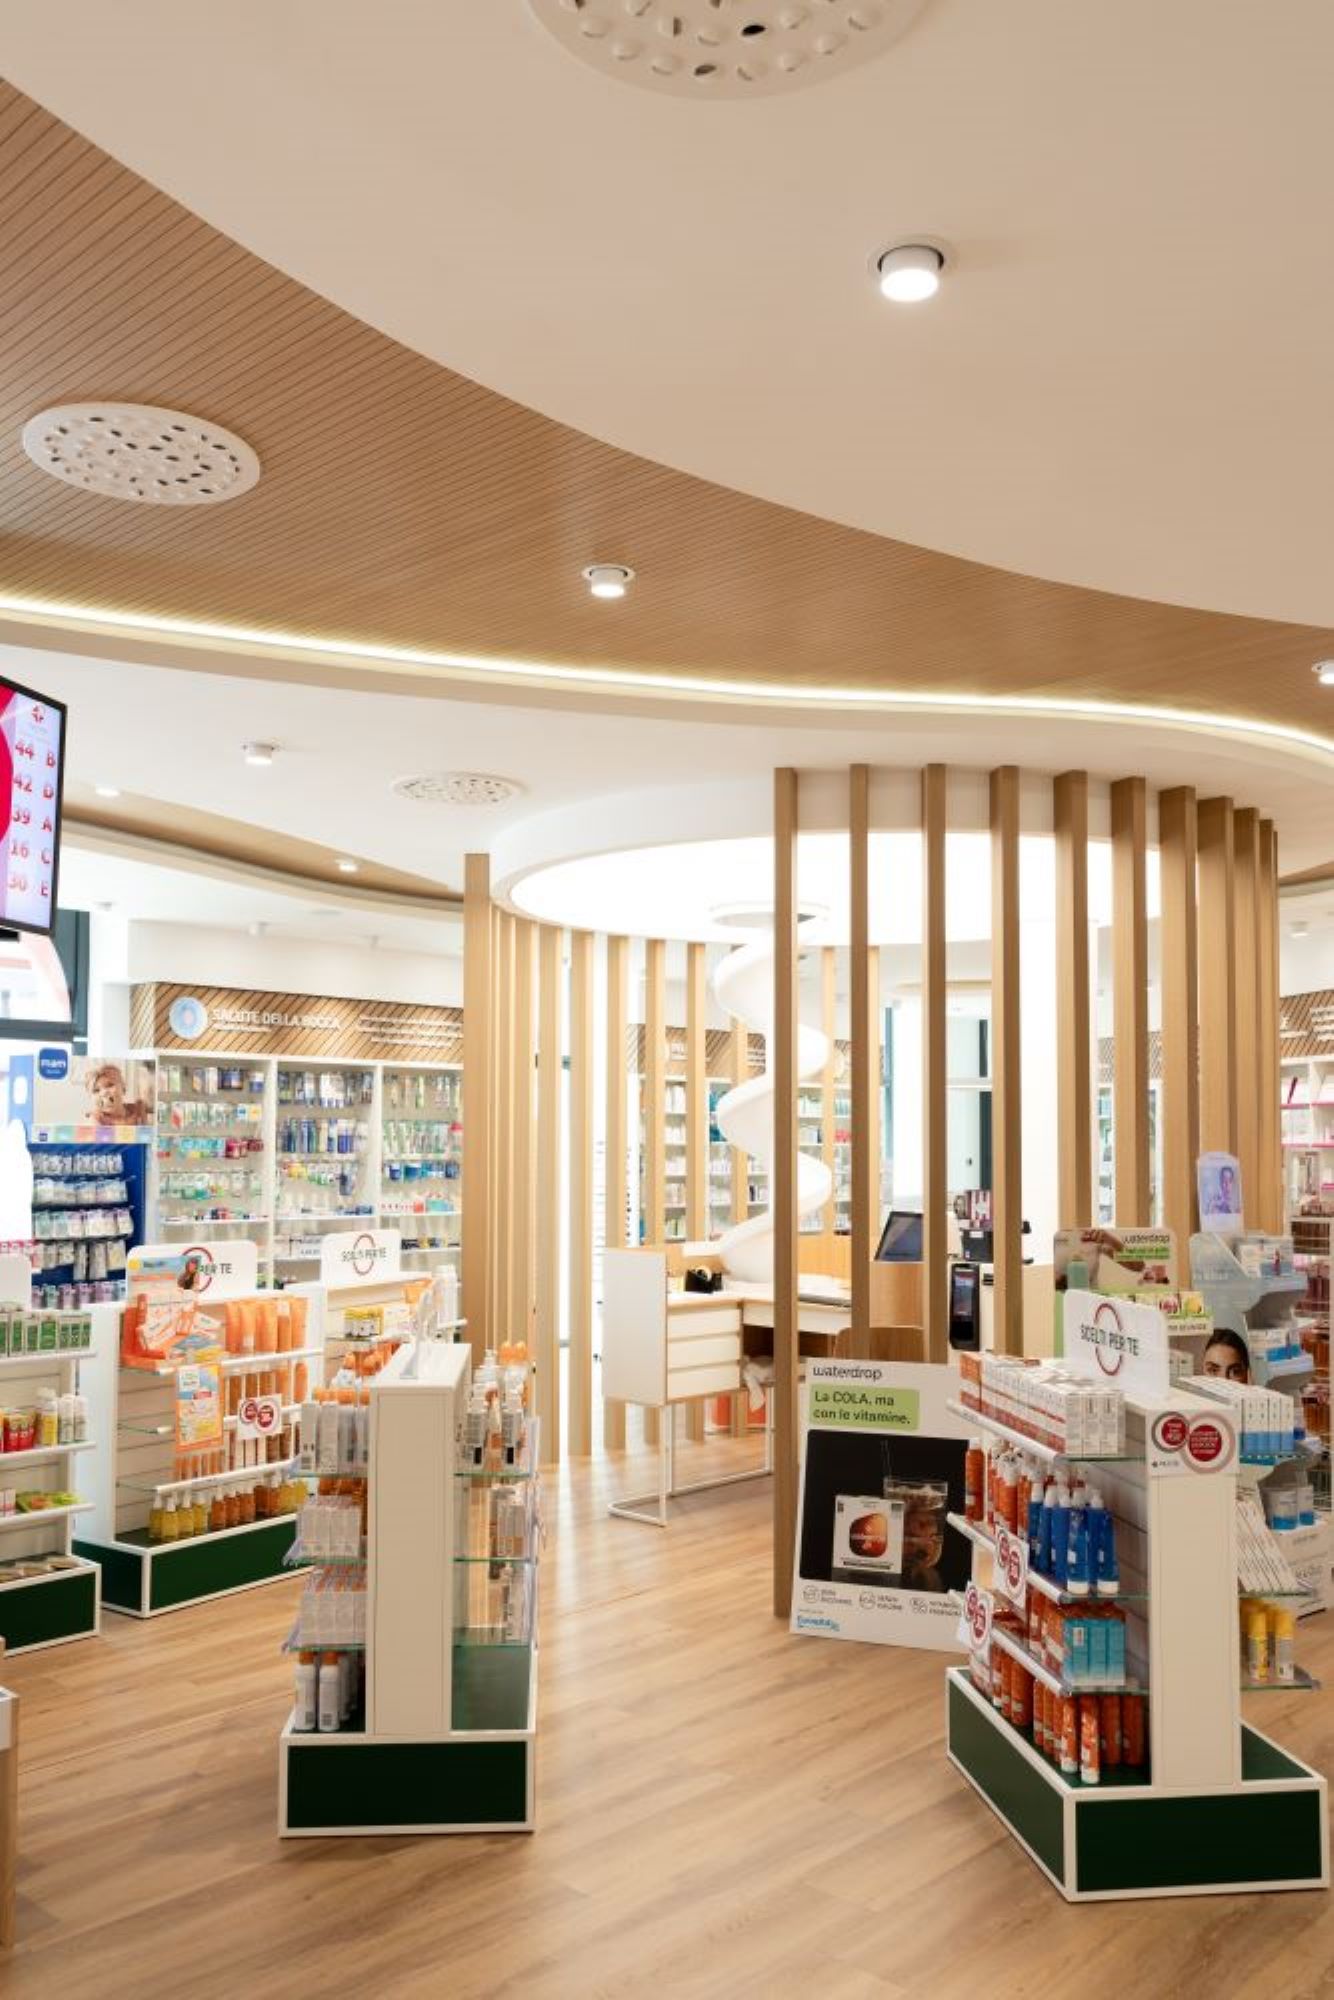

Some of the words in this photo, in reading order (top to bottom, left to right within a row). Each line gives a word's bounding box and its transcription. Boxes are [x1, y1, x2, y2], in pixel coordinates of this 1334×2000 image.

[15, 739, 35, 759] 44
[47, 751, 56, 767] B
[13, 775, 33, 793] 42
[12, 808, 30, 824] 39
[42, 817, 52, 832] A
[41, 849, 51, 865] C
[40, 882, 49, 898] E
[212, 1008, 260, 1024] SALUTE
[263, 1012, 300, 1026] DELLA
[220, 1263, 233, 1275] TE
[1080, 1323, 1107, 1346] SCELTI
[1109, 1332, 1126, 1352] PER
[1127, 1336, 1139, 1357] TE
[813, 1365, 883, 1383] waterdrop
[814, 1391, 830, 1402] La
[875, 1395, 895, 1407] ma
[813, 1409, 836, 1420] con
[839, 1408, 850, 1421] le
[853, 1410, 911, 1425] vitamine.
